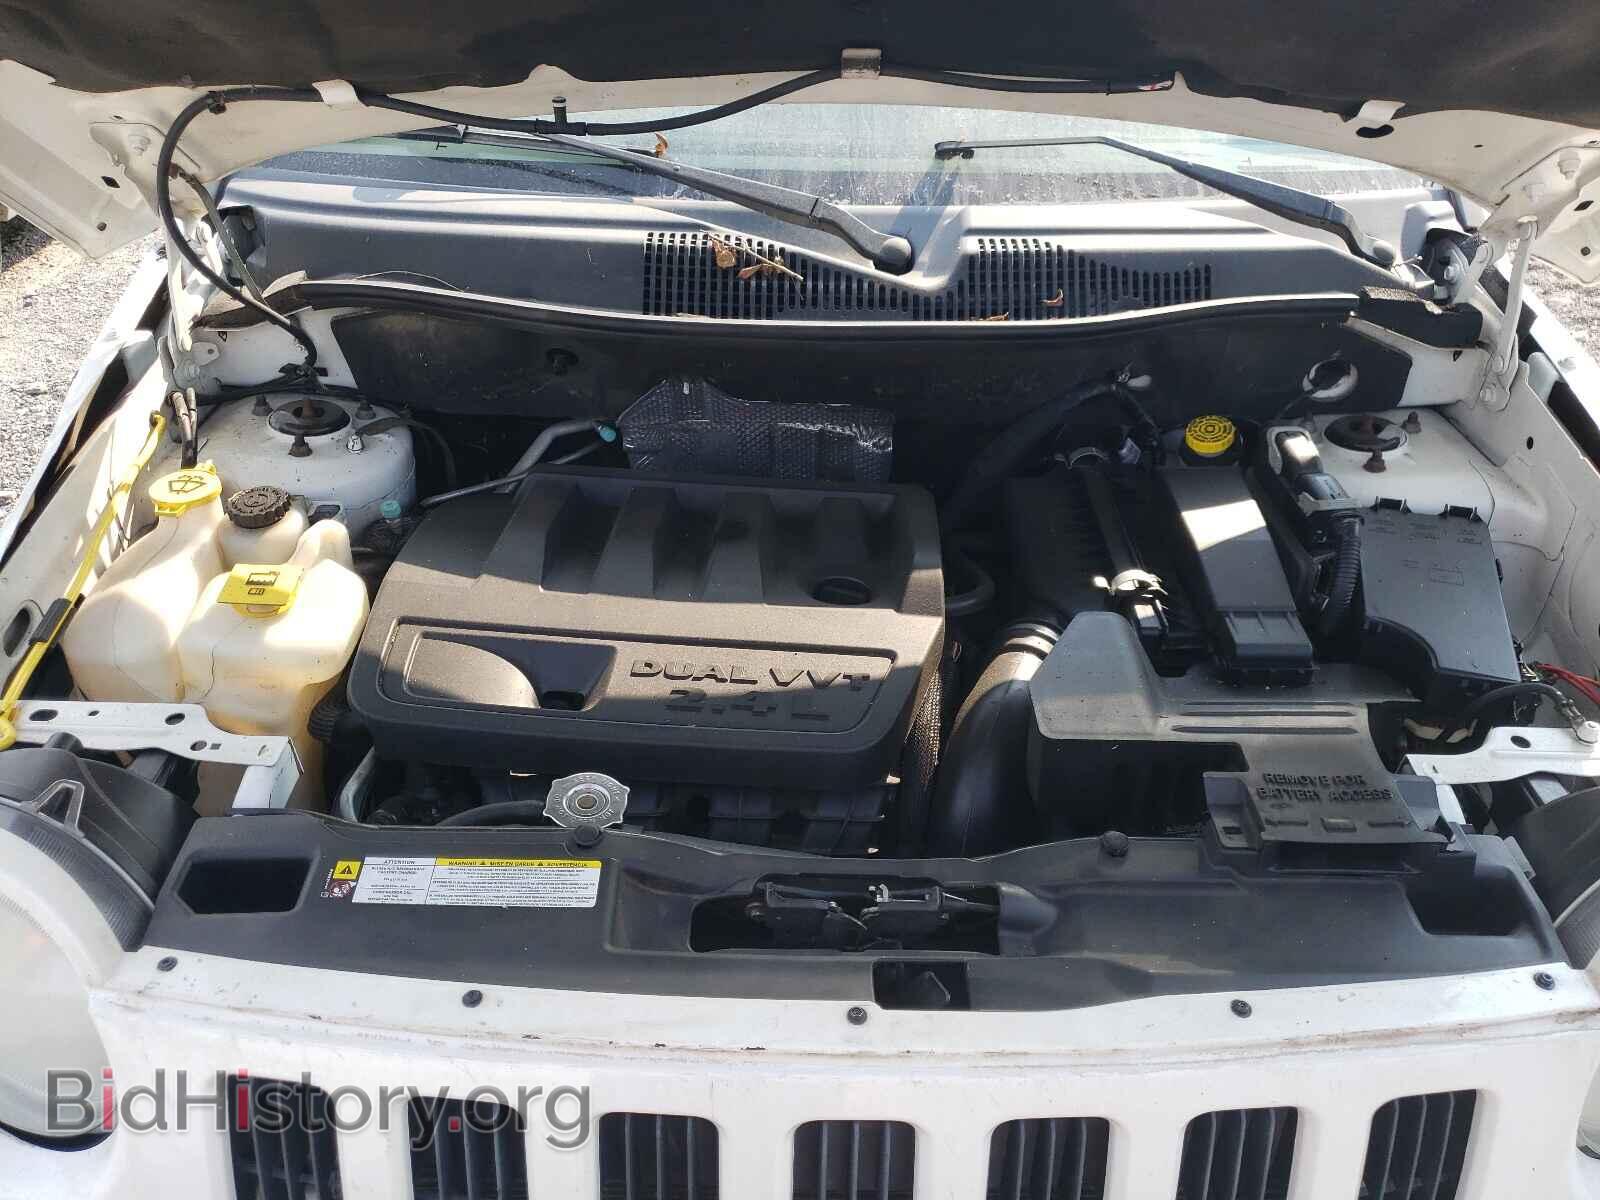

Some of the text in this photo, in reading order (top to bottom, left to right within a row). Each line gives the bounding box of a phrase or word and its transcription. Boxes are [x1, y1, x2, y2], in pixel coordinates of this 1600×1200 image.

[629, 659, 871, 692] DUAL VVT
[1262, 772, 1368, 787] REMOVE FOR
[1327, 788, 1393, 802] ACCESS
